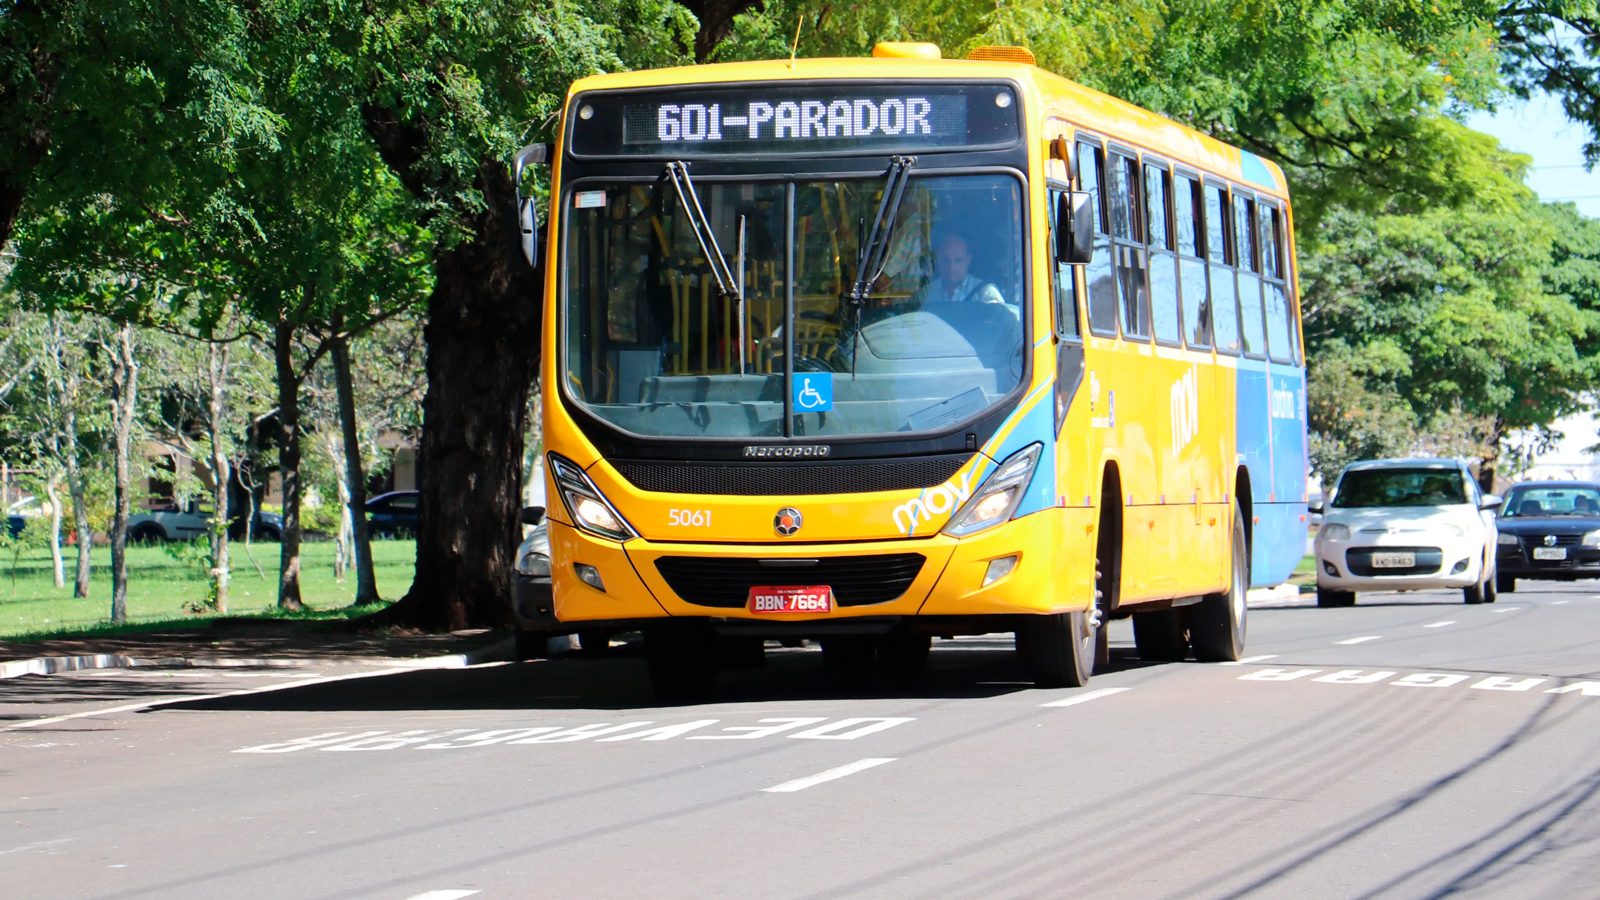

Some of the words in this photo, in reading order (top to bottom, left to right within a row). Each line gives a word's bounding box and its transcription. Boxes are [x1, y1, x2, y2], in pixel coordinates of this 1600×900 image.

[657, 97, 932, 141] 601-PARADOR
[744, 446, 829, 457] Marcopolo
[667, 508, 712, 527] 5061
[892, 472, 971, 534] mov
[230, 716, 918, 753] DEVAGAR
